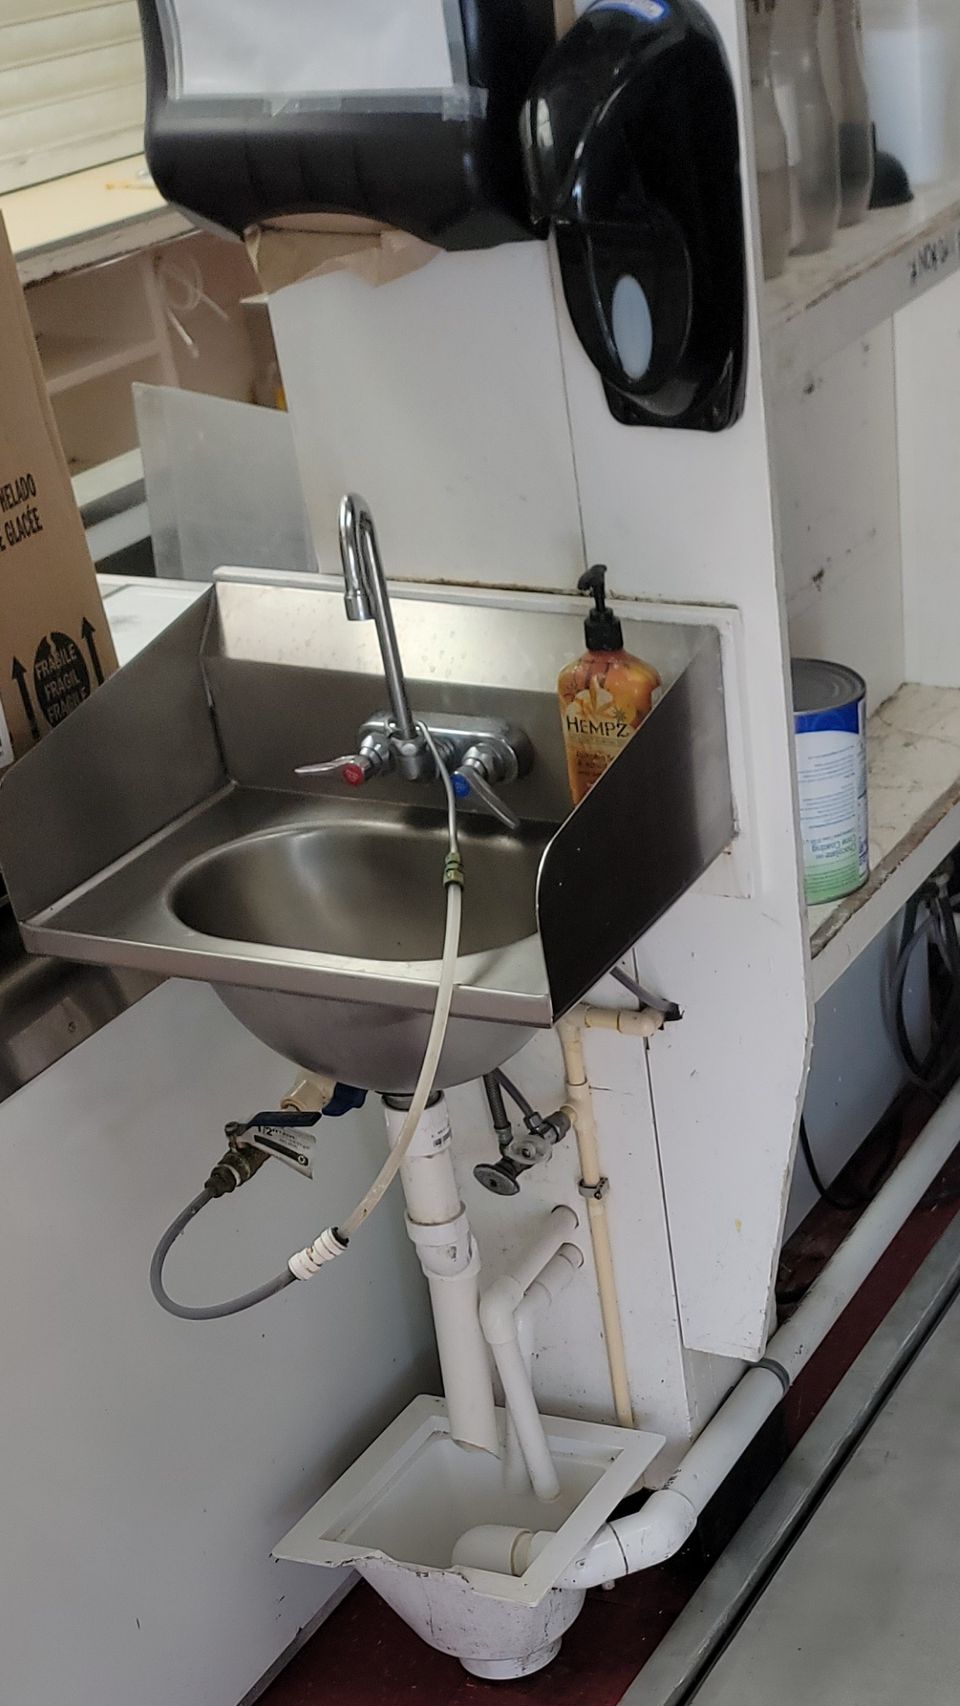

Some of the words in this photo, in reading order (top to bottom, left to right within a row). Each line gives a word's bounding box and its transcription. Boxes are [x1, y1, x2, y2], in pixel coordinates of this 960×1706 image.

[0, 473, 37, 512] HELADO
[4, 504, 43, 546] GLACÉE
[566, 715, 630, 738] HEMPZ
